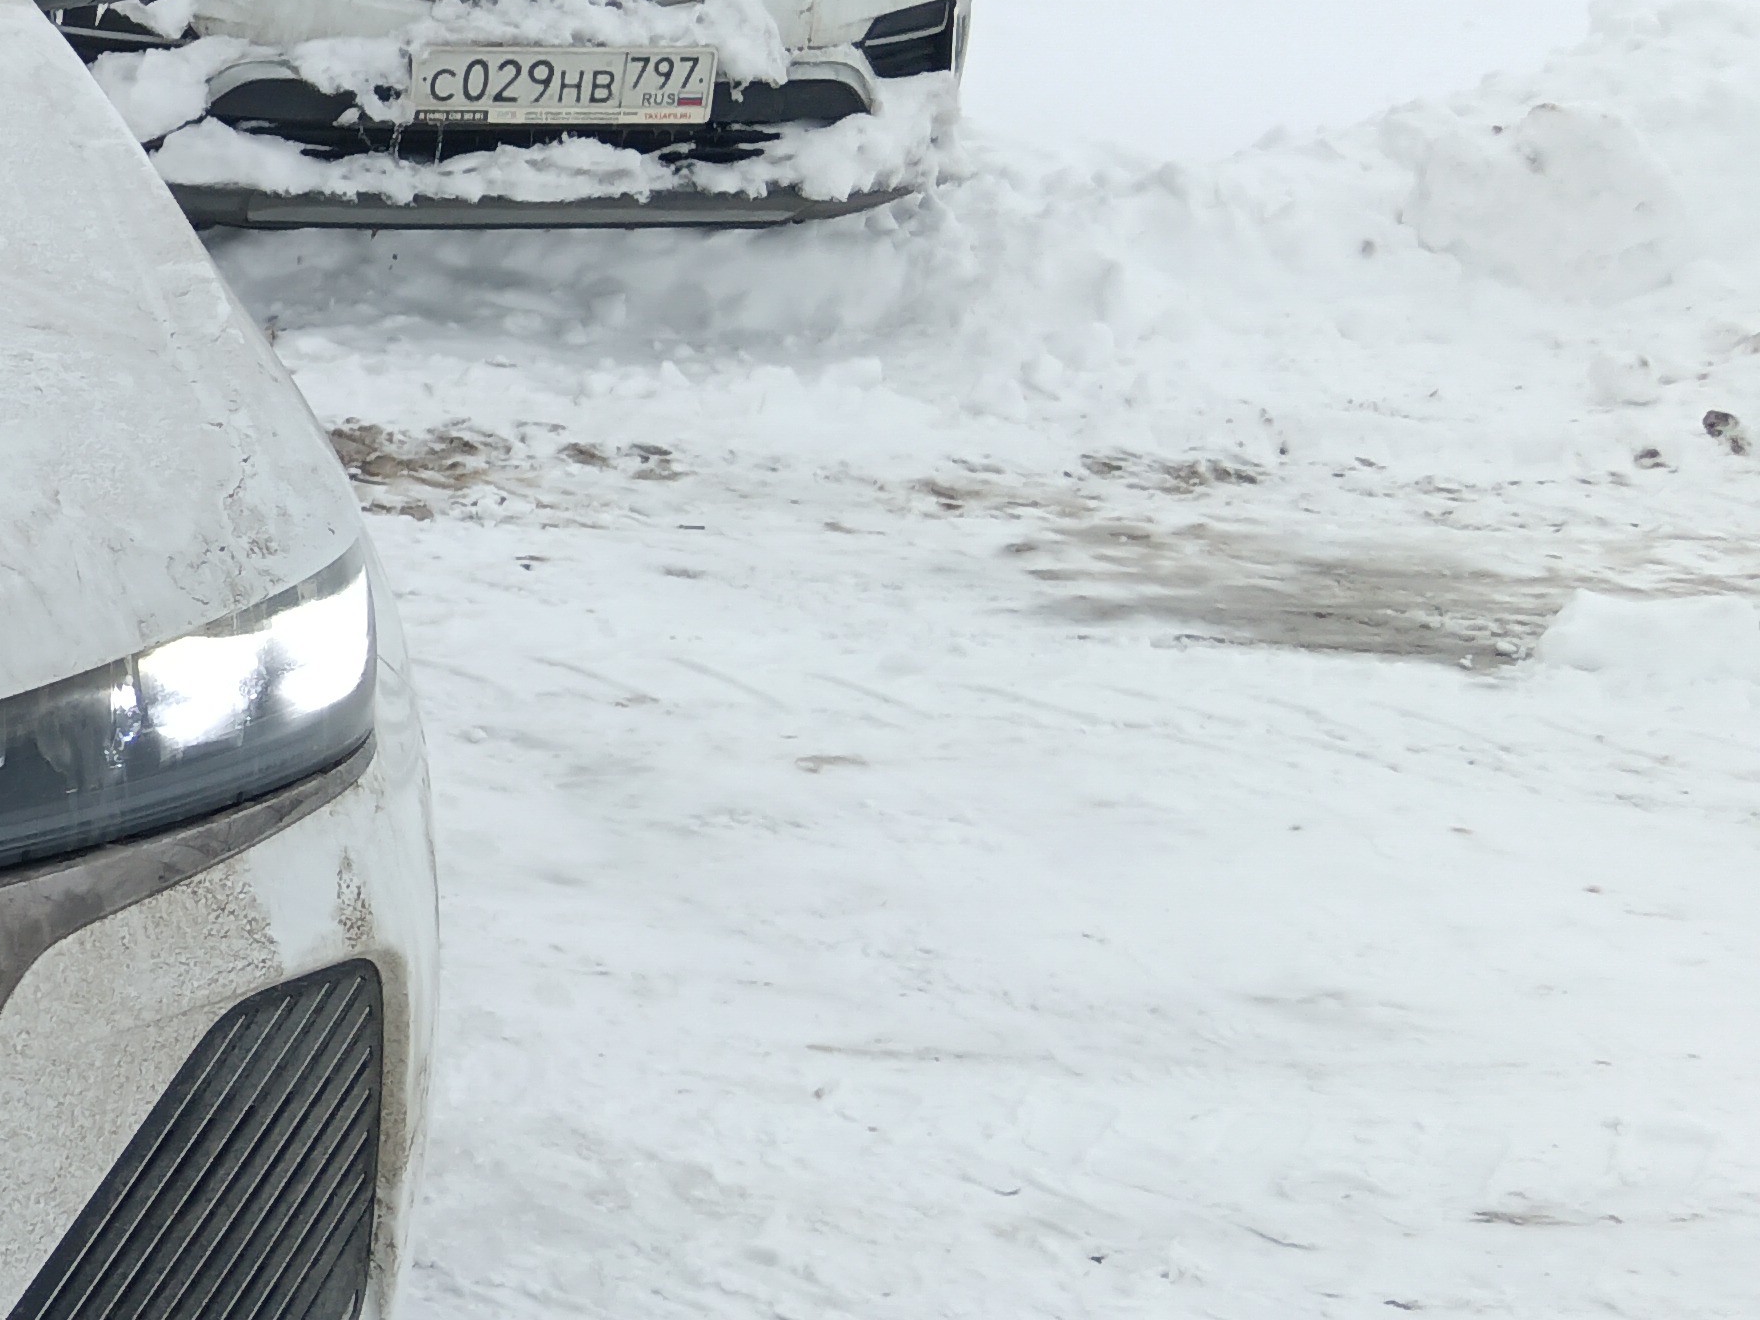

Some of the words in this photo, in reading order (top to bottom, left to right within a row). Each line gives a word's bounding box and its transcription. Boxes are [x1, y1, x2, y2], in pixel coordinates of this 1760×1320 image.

[430, 58, 615, 104] С029НВ
[630, 56, 699, 91] 797
[641, 92, 675, 107] RUS
